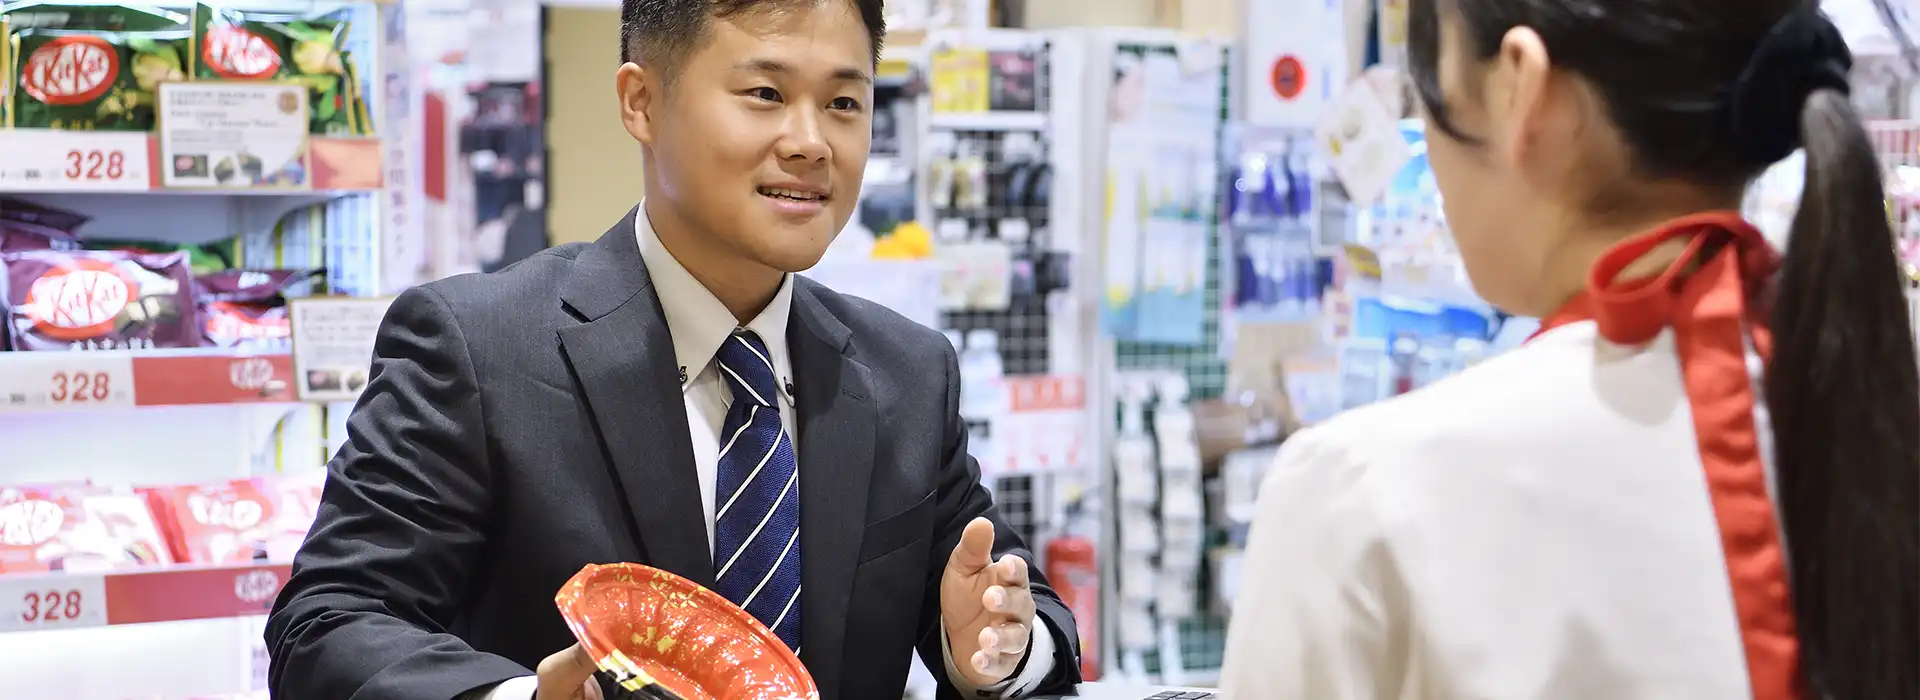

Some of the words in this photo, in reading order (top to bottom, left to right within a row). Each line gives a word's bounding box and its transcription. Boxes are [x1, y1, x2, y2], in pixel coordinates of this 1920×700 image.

[38, 42, 106, 95] KitKat
[66, 150, 123, 179] 328
[51, 372, 109, 401] 328
[23, 591, 81, 621] 328
